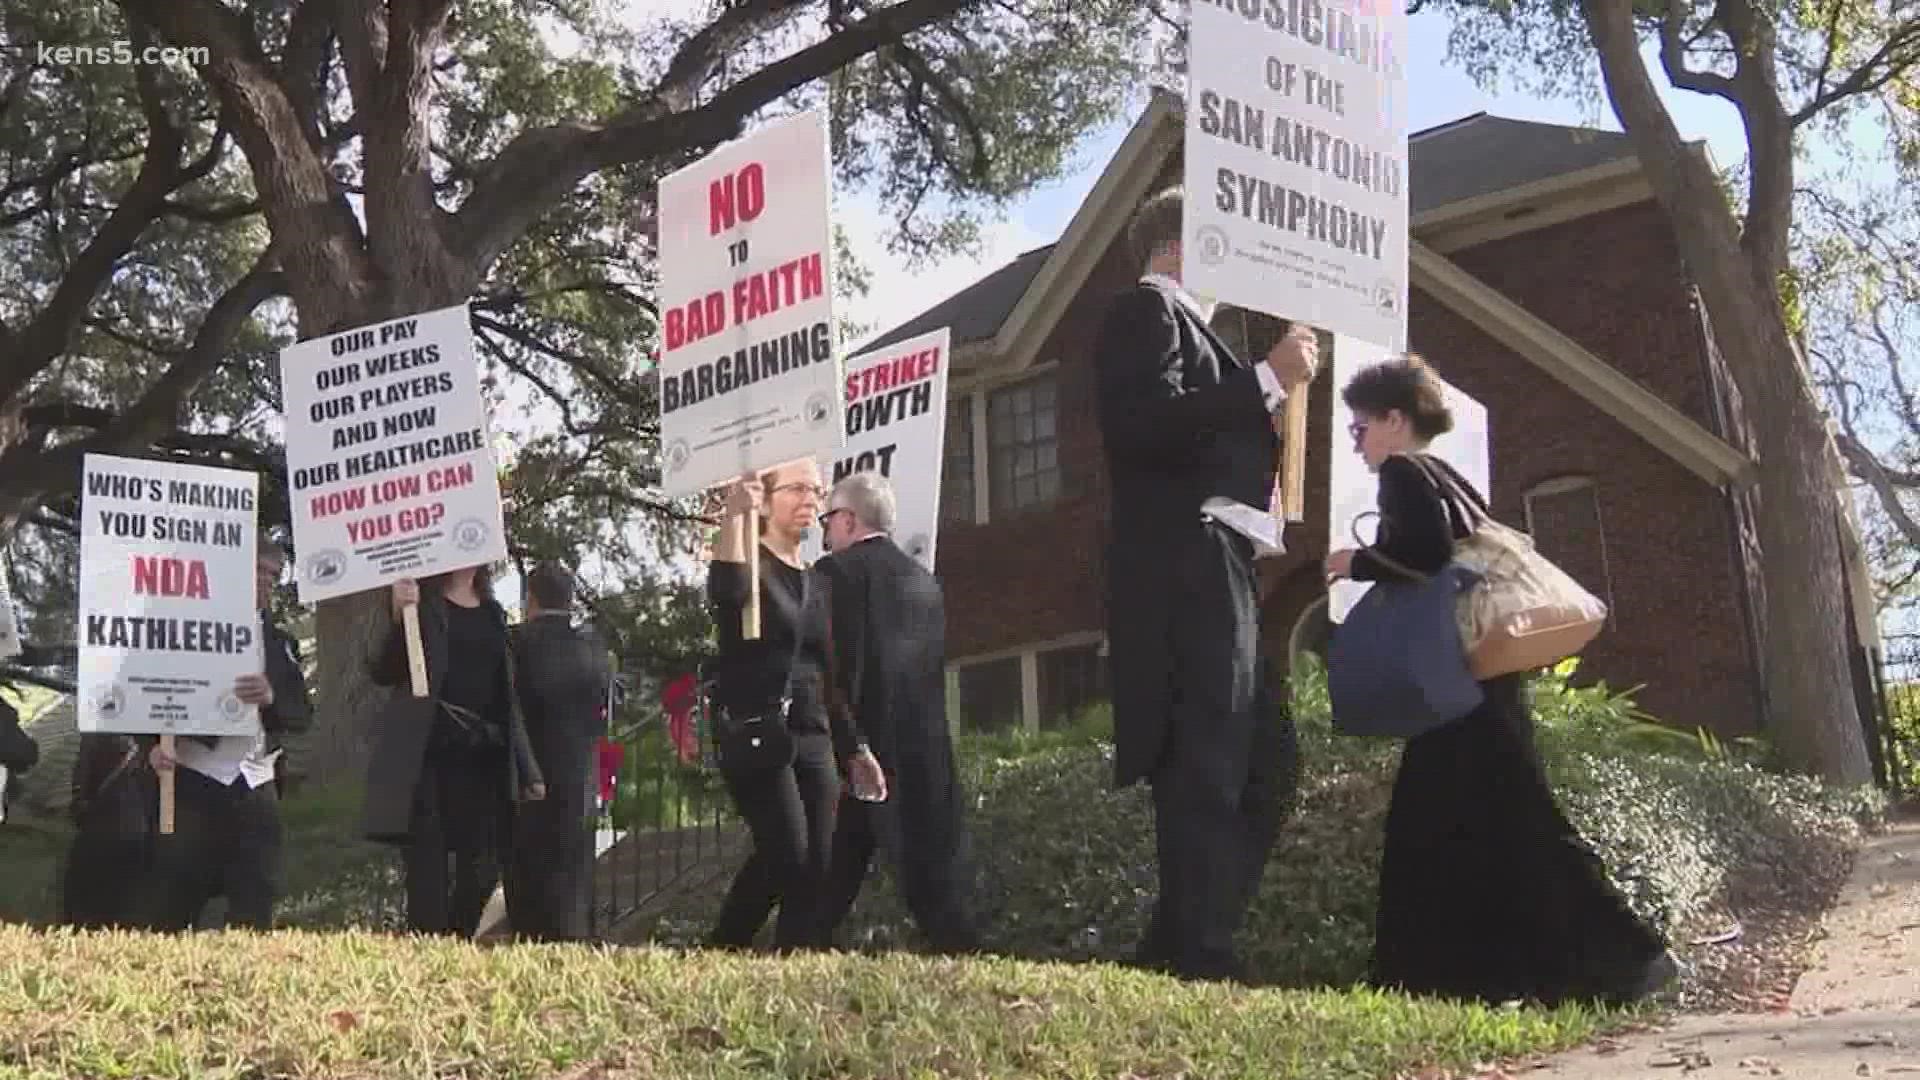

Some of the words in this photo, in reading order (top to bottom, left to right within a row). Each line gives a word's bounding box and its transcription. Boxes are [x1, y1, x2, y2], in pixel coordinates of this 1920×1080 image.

[1266, 56, 1296, 96] OF
[1305, 67, 1345, 116] THE
[1199, 89, 1264, 150] SAN
[709, 162, 766, 236] NO
[1216, 167, 1385, 260] SYMPHONY
[727, 238, 749, 268] TO
[665, 292, 726, 352] BAD
[732, 252, 822, 326] FAITH
[330, 331, 375, 357] OUR
[381, 319, 418, 348] PAY
[316, 363, 360, 391] OUR
[365, 344, 441, 378] WEEKS
[663, 322, 830, 414] BARGAINING
[847, 346, 940, 402] STRIKE!
[310, 396, 356, 423] OUR
[360, 372, 454, 412] PLAYERS
[846, 381, 931, 437] OWTH
[332, 420, 378, 450] AND
[383, 406, 436, 437] NOW
[294, 462, 340, 490] OUR
[345, 428, 484, 480] HEALTHCARE
[88, 471, 163, 503] WHO'S
[168, 480, 255, 512] MAKING
[310, 486, 367, 519] HOW
[372, 475, 422, 505] LOW
[427, 462, 475, 493] CAN
[100, 510, 146, 539] YOU
[152, 516, 207, 544] SIGN
[212, 522, 242, 548] AN
[346, 513, 393, 544] YOU
[399, 502, 446, 533] GO?
[133, 556, 211, 600] NDA
[87, 615, 252, 654] KATHLEEN?
